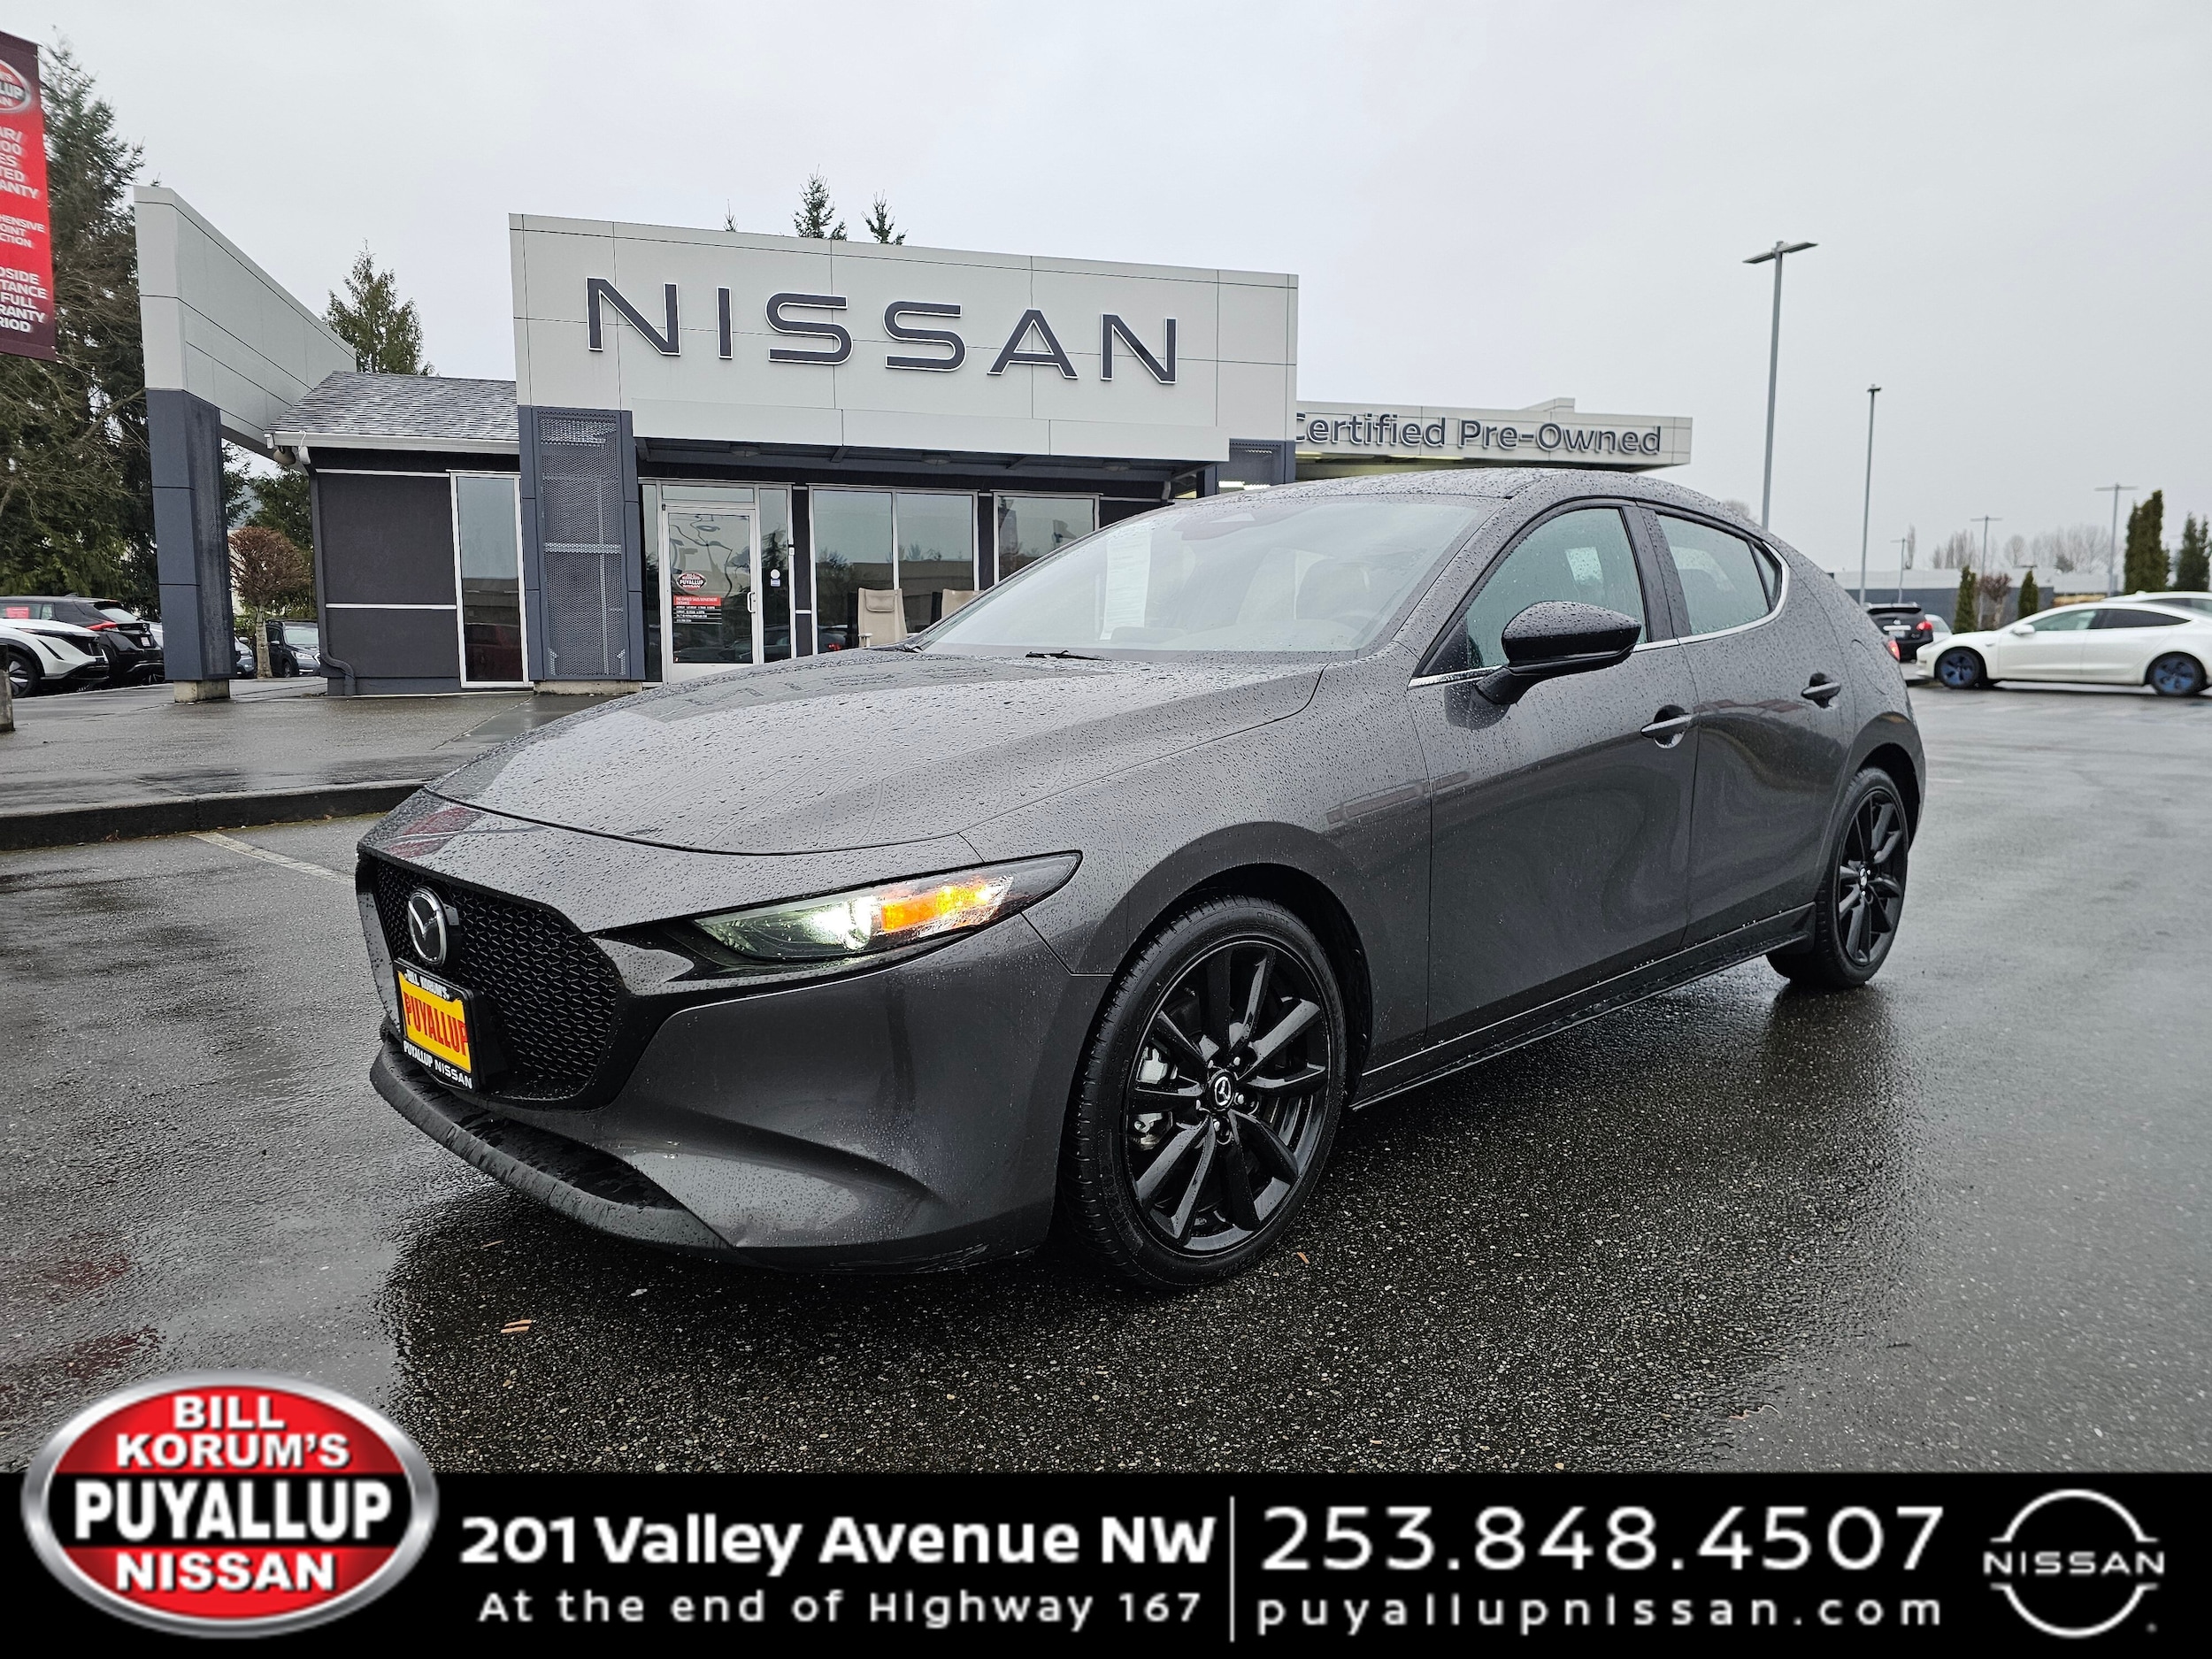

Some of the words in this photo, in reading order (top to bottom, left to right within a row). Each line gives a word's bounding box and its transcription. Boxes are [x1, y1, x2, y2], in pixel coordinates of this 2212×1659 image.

[0, 126, 22, 142] RI
[1, 291, 37, 310] FULL
[586, 277, 1178, 385] NISSAN
[1458, 419, 1662, 453] Pre-Owned
[403, 991, 468, 1056] PUYALLUP
[403, 1041, 433, 1067] PUYALLUP
[434, 1059, 472, 1089] NISSAN
